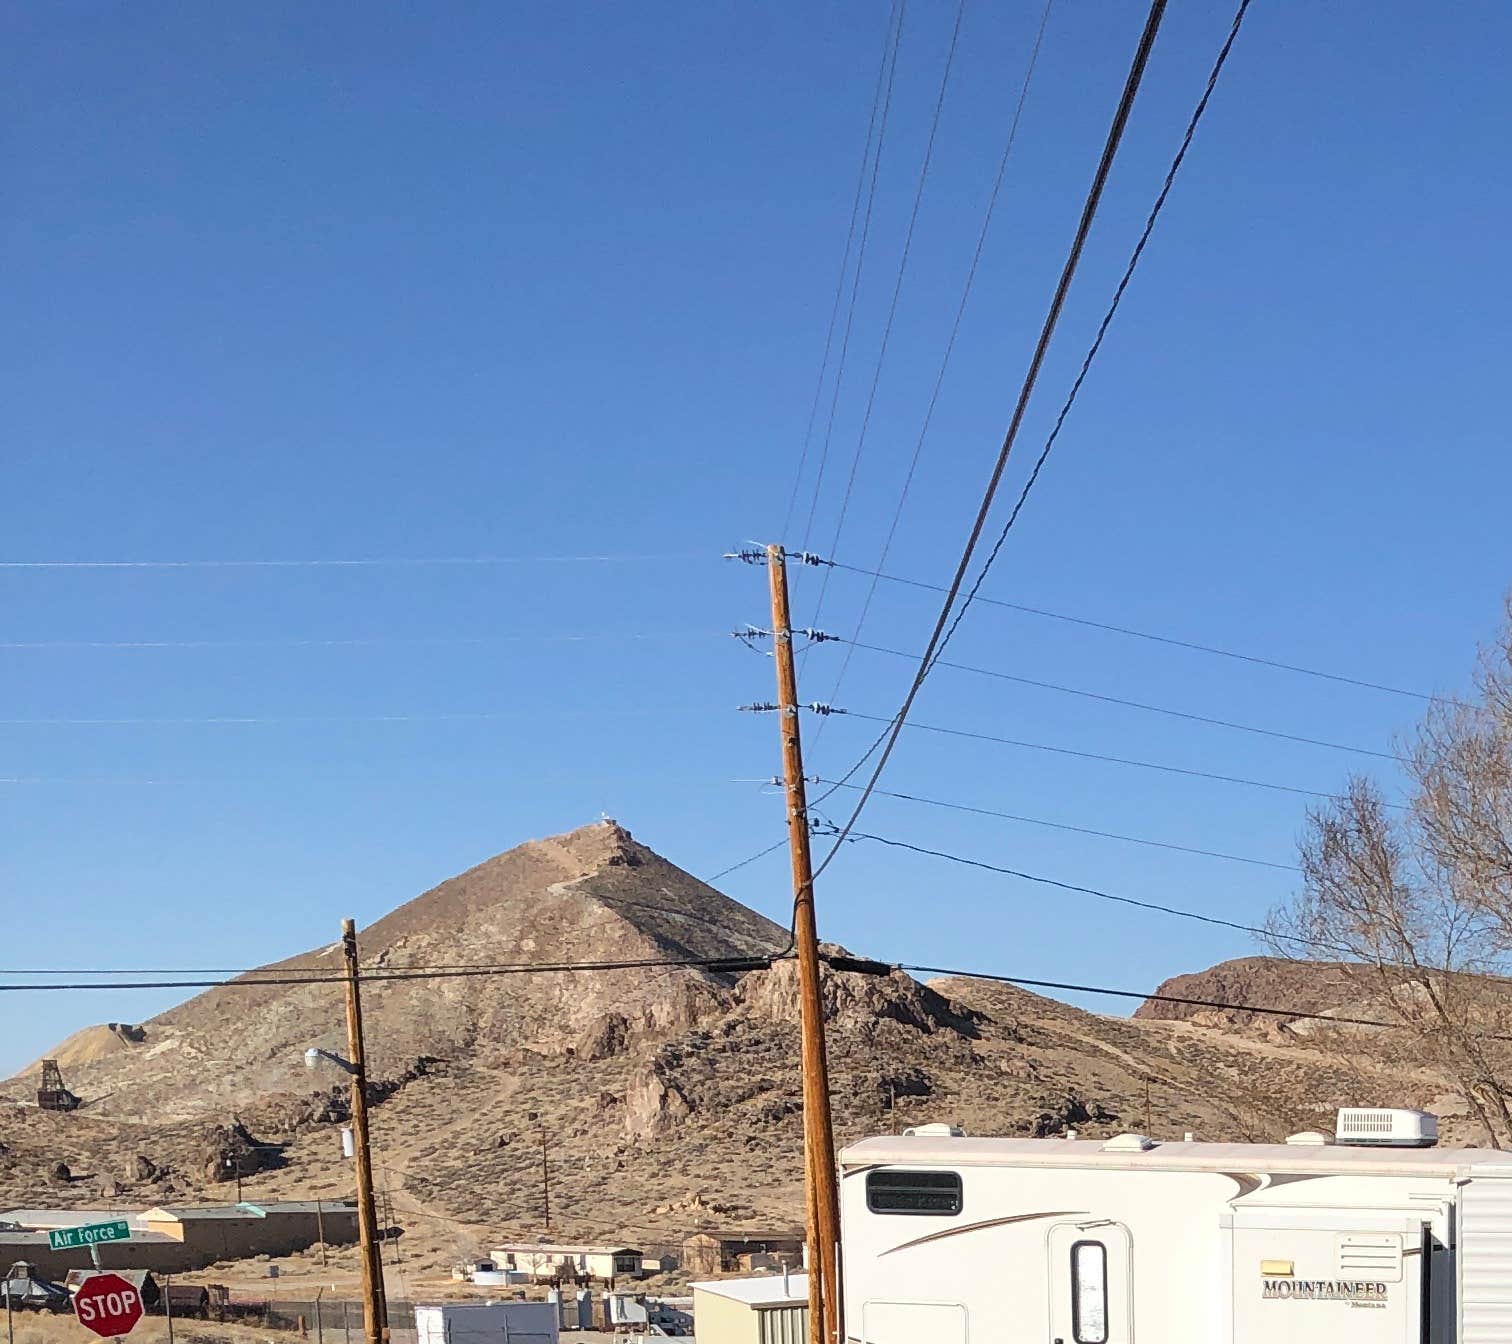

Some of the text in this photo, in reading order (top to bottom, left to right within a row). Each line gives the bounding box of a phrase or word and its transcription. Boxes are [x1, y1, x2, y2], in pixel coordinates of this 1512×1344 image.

[54, 1227, 115, 1247] Air Force
[79, 1290, 136, 1321] STOP
